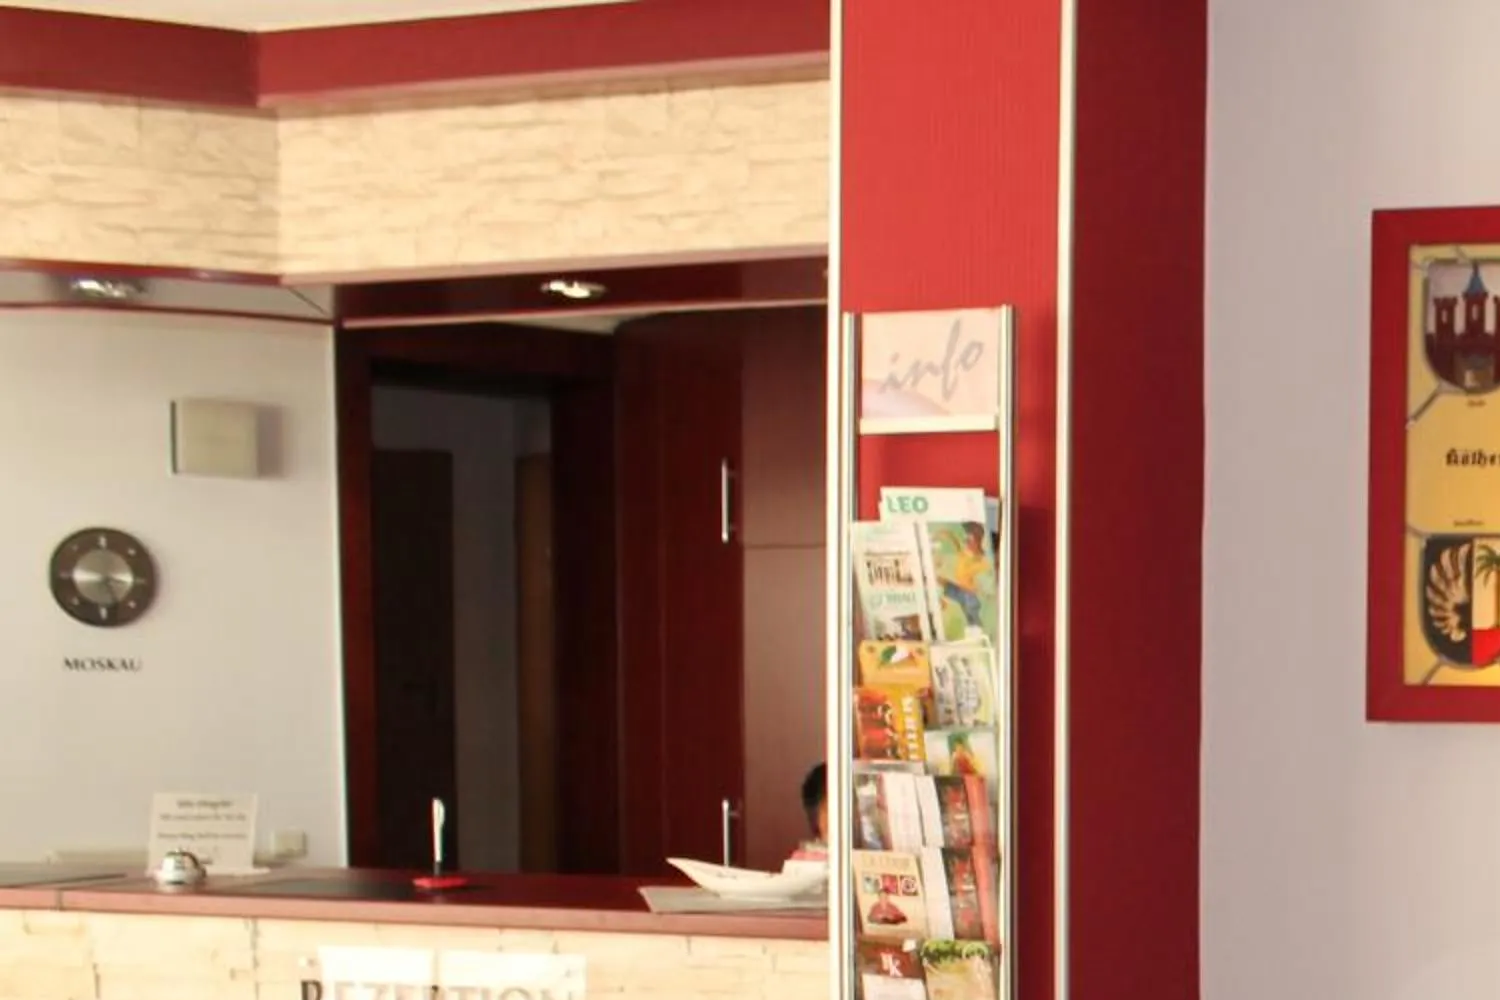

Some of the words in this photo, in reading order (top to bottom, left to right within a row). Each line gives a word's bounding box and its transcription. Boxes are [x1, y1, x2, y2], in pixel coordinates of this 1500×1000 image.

[877, 318, 985, 401] info
[886, 496, 929, 514] LEO
[64, 656, 142, 672] MOSKAU
